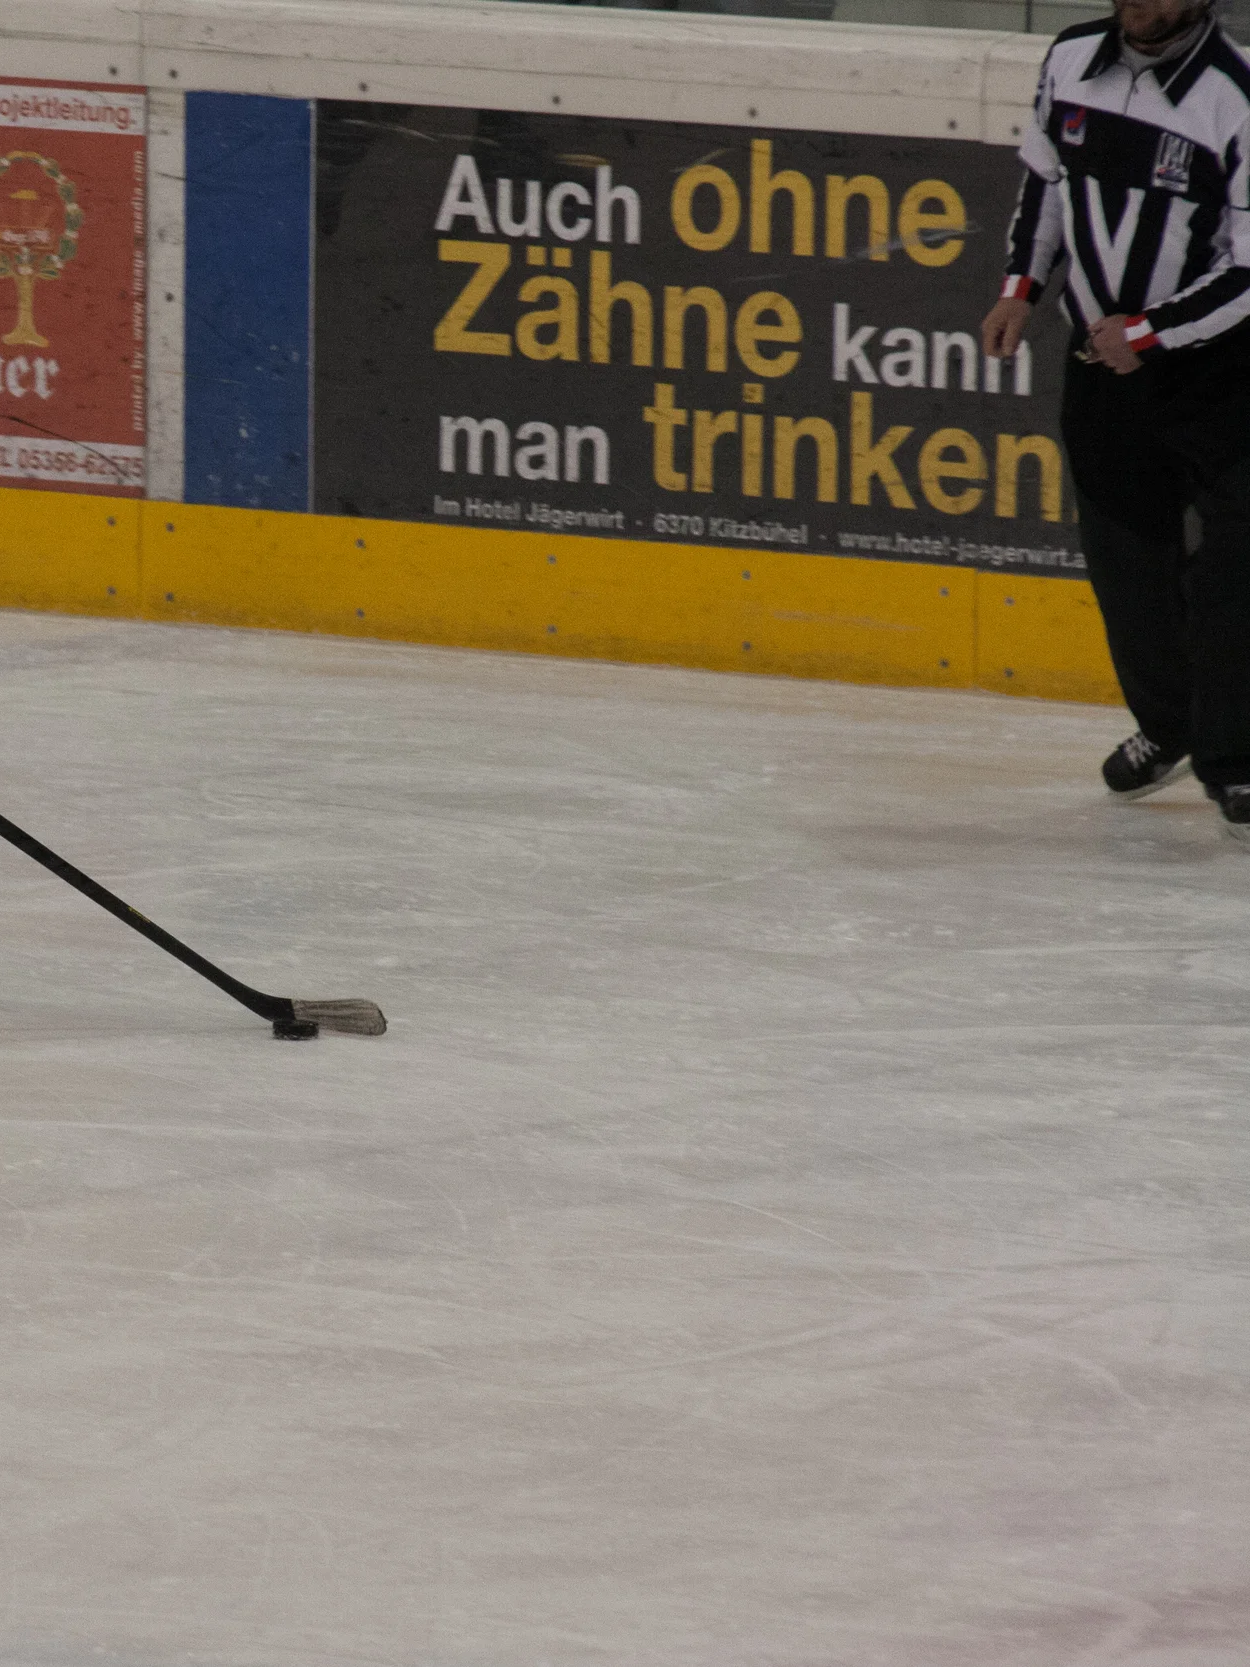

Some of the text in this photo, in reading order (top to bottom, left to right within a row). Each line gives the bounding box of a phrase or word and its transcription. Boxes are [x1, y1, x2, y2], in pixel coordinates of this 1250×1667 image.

[434, 138, 968, 267] Auch ohne
[433, 239, 1033, 396] Zähne kann
[438, 415, 610, 486] man
[433, 495, 1088, 570] Im Hotel Jägerwirt 6370 Kitzbühel www.hotel-jaegerwirt.a
